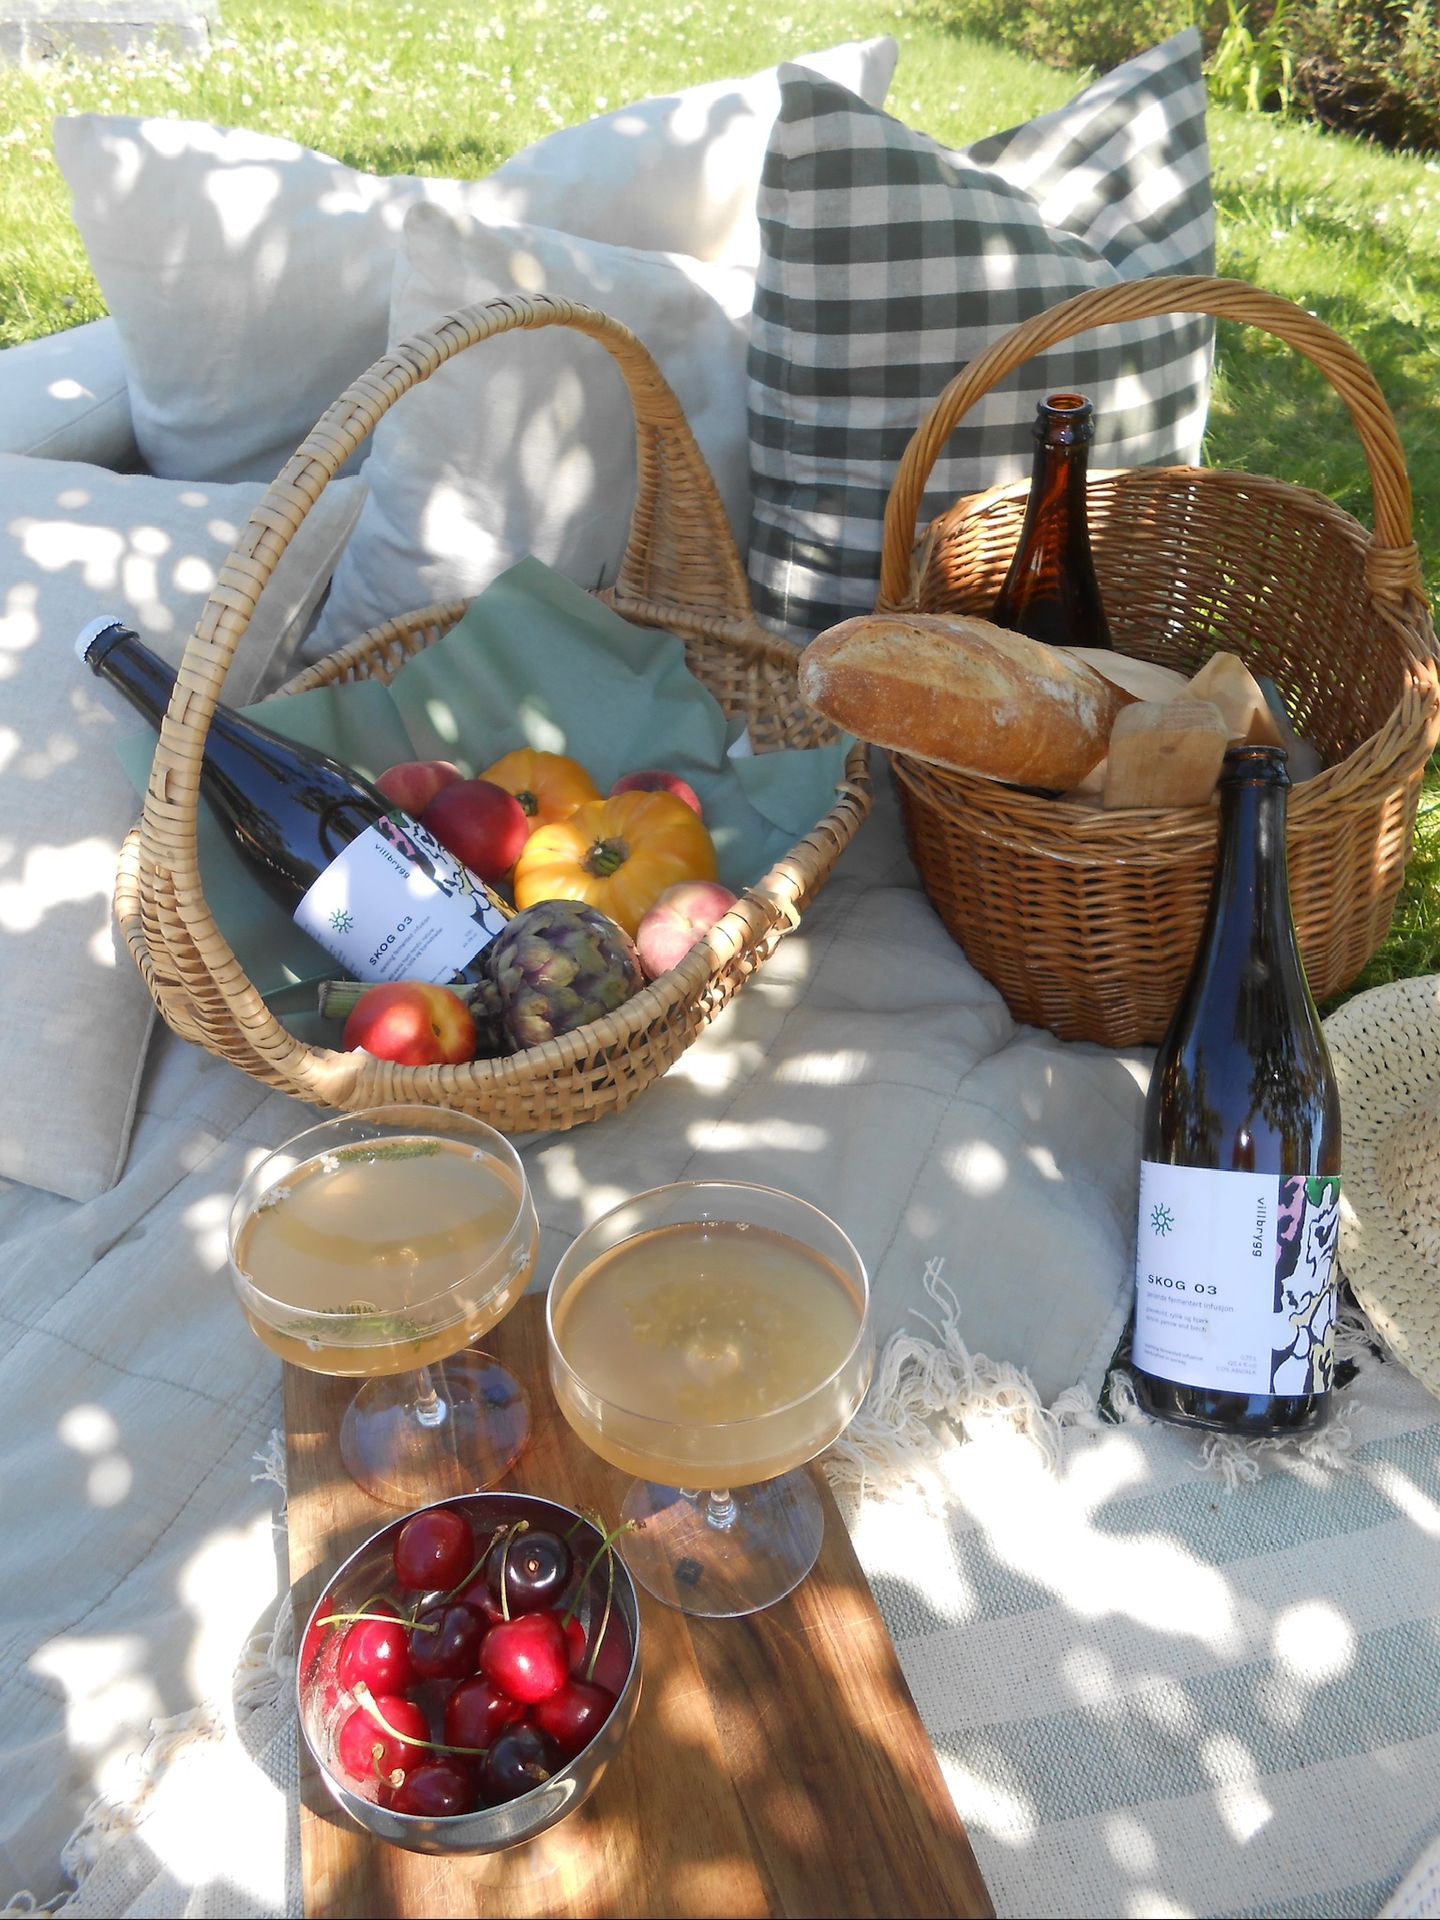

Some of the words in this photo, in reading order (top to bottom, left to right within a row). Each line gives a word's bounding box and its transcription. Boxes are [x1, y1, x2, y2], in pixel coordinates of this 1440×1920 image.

[375, 843, 410, 879] villbrygg
[369, 933, 396, 966] SKOG
[1252, 1197, 1266, 1258] villbrygg
[1147, 1274, 1186, 1291] SKOG
